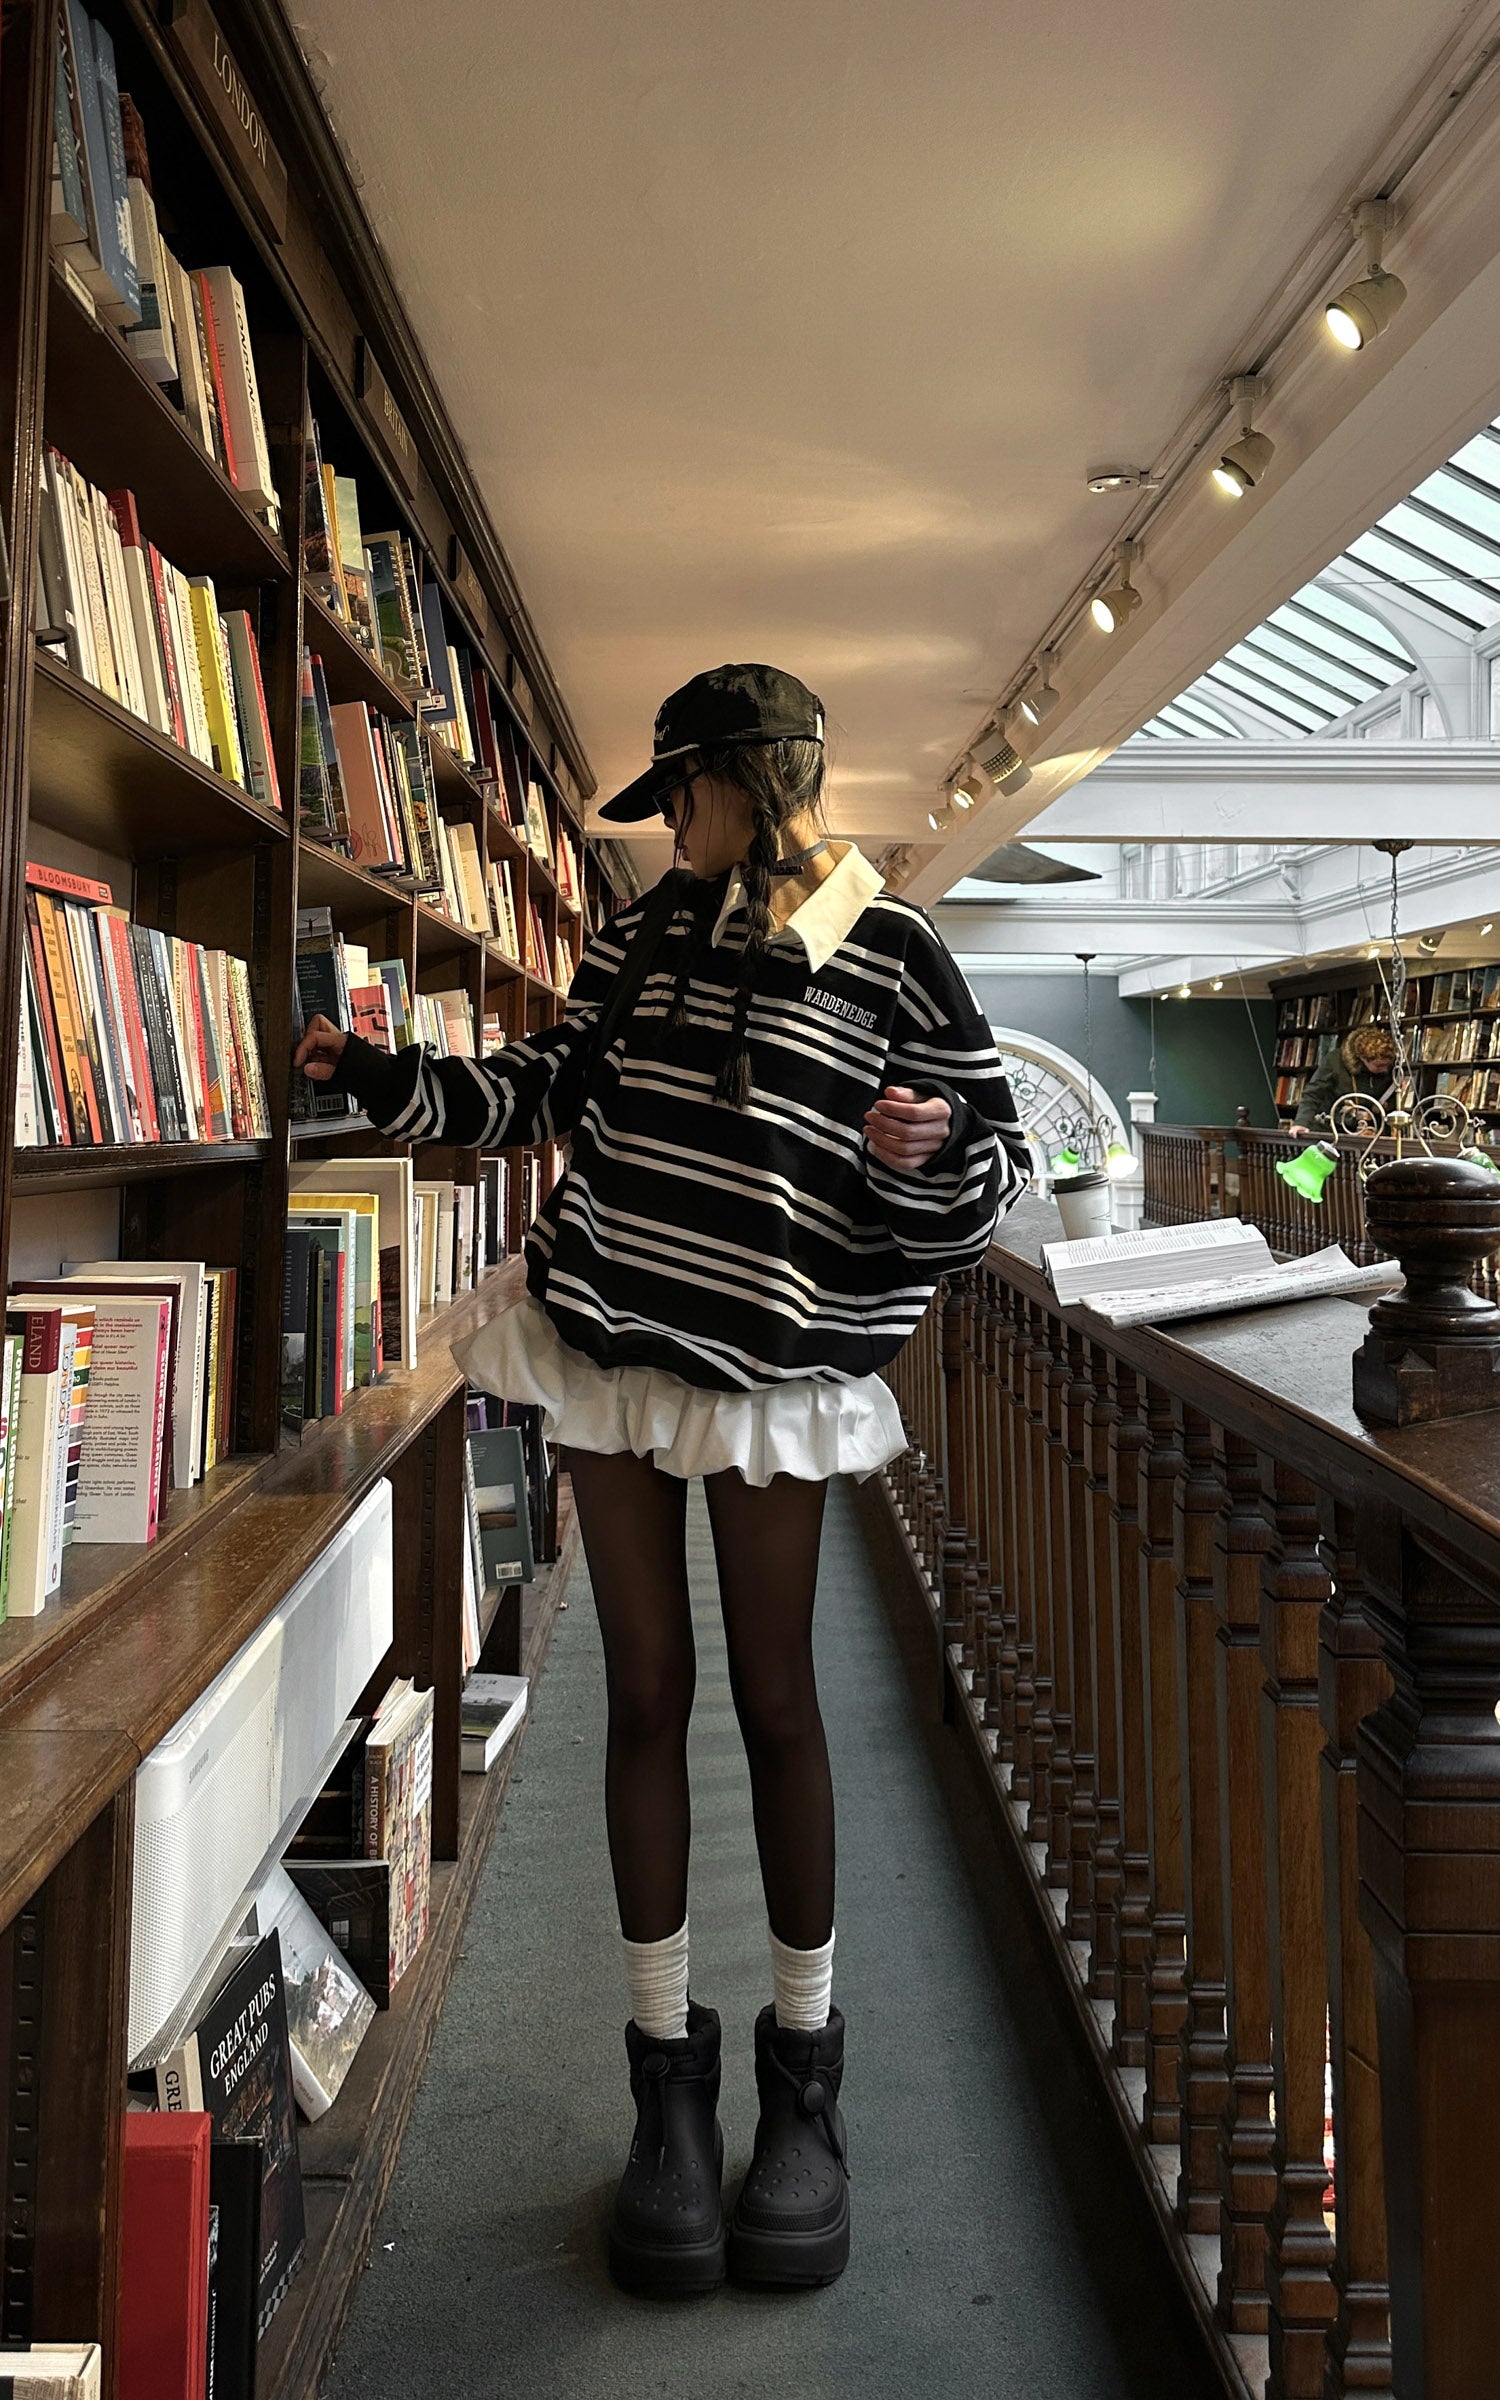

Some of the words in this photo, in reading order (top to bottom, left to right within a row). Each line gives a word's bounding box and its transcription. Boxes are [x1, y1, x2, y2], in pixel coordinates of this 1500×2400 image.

[213, 31, 267, 168] LONDON
[235, 300, 256, 404] LONDON
[160, 602, 175, 664] WICKED
[168, 668, 179, 703] BOY
[38, 868, 92, 894] BLOOMSBURY
[143, 972, 151, 1000] Brick
[148, 1002, 156, 1029] Lane
[154, 943, 165, 976] Slow
[160, 975, 168, 1009] Burn
[164, 1009, 173, 1038] City
[170, 1044, 178, 1077] Rowan
[175, 1078, 183, 1111] Moore
[803, 985, 878, 1030] WARDENEDGE
[197, 1029, 206, 1083] Sinclair
[28, 1316, 46, 1369] ELAND
[158, 1349, 166, 1399] QUEER
[11, 1347, 23, 1431] FORTRESS
[57, 1343, 71, 1441] LONDON
[6, 1435, 18, 1511] LONDON
[153, 1402, 164, 1497] FOOTPRINTS
[189, 1748, 209, 1785] SAMSUNG
[370, 1776, 379, 1784] A
[369, 1786, 379, 1831] HISTORY
[369, 1832, 378, 1847] OF
[209, 2008, 251, 2079] GREAT
[248, 1973, 277, 2028] PUBS
[223, 2022, 269, 2097] ENGLAND
